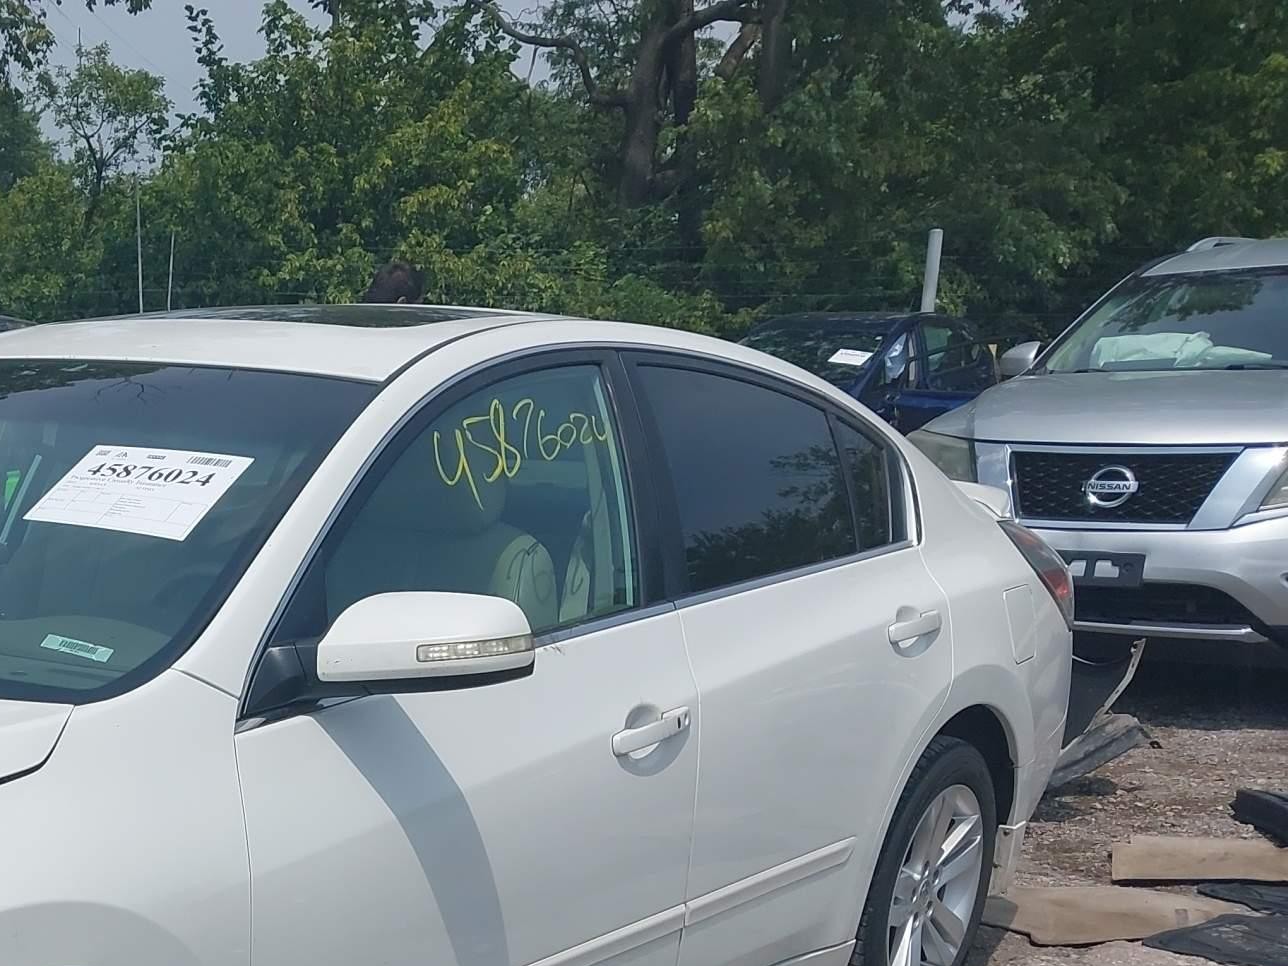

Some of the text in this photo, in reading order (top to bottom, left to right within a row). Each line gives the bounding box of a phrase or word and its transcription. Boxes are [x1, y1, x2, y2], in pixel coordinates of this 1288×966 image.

[433, 398, 608, 512] 45876024
[87, 462, 216, 487] 45876024
[1087, 482, 1132, 491] NISSAN
